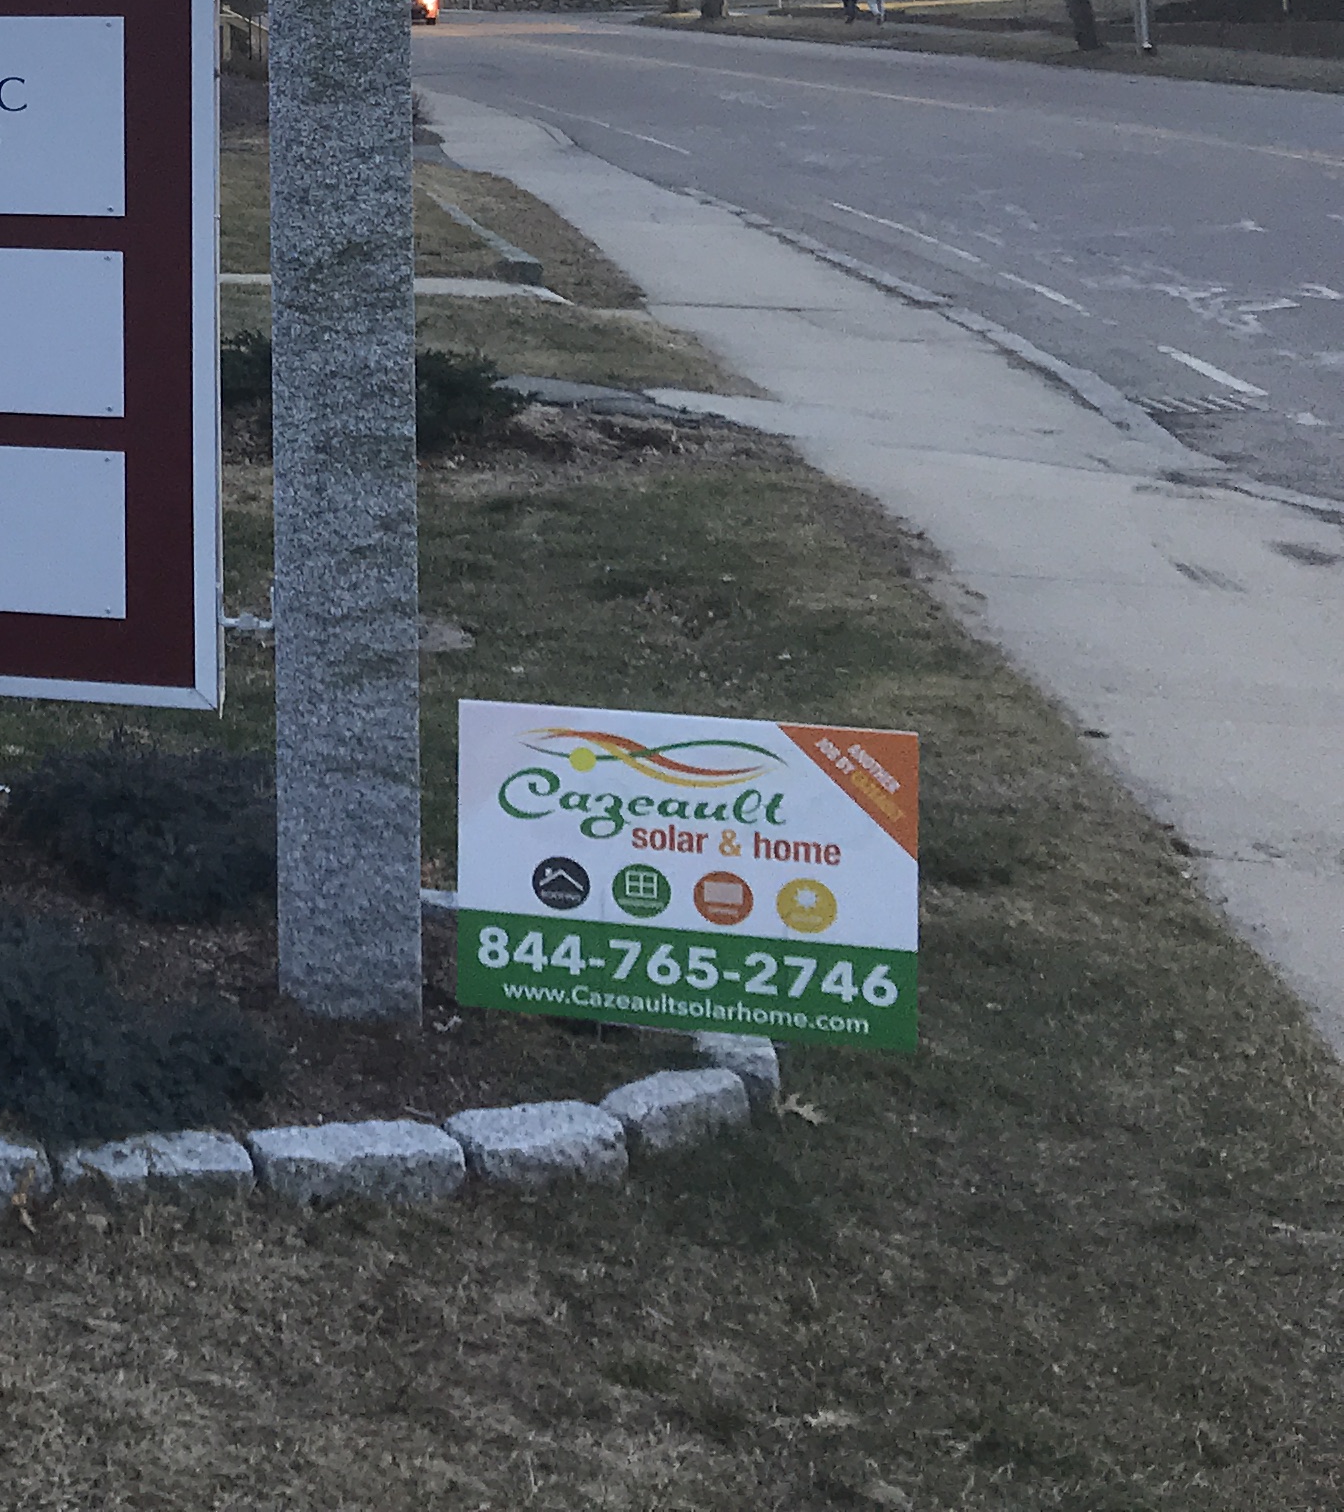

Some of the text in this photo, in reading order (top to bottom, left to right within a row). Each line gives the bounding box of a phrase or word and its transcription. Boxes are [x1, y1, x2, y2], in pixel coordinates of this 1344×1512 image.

[498, 766, 787, 840] Cazeault
[631, 824, 843, 866] solar & home
[477, 925, 900, 1008] 844-765-2746
[502, 980, 871, 1035] www.Cazeaultsolarhome.com
